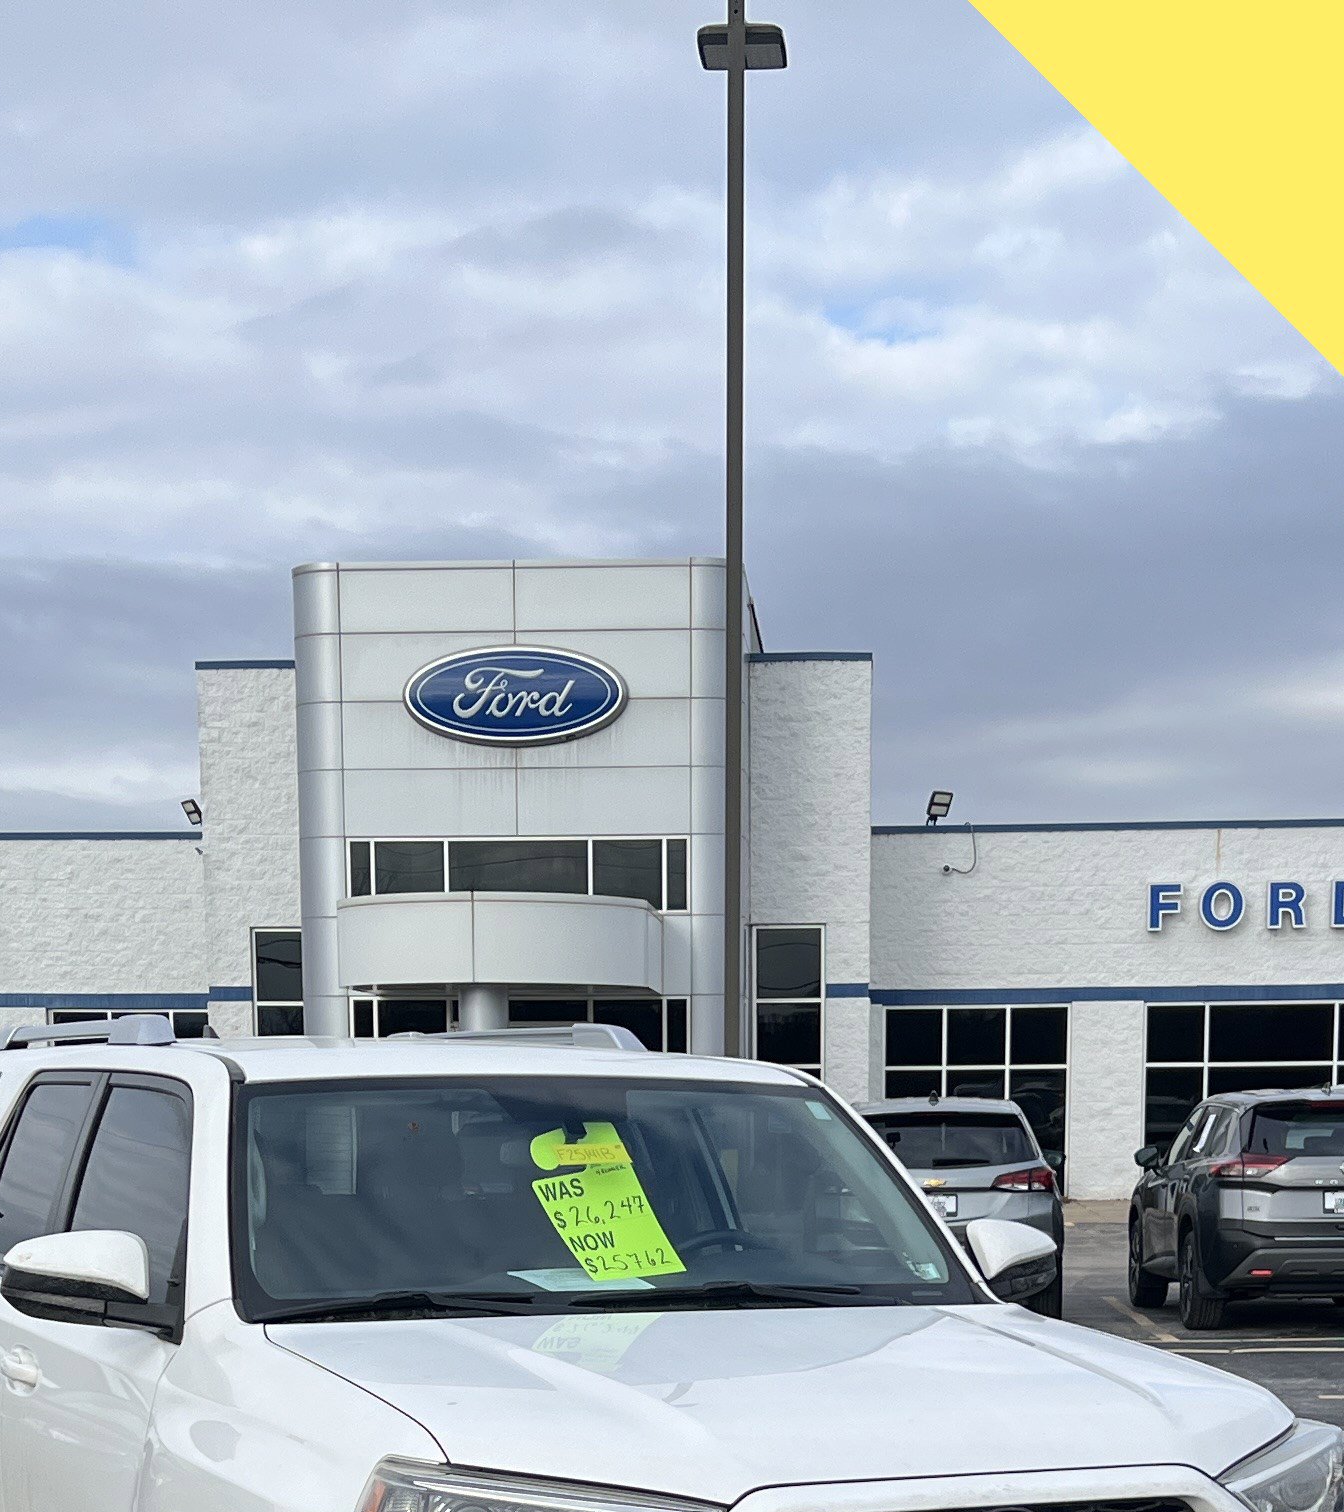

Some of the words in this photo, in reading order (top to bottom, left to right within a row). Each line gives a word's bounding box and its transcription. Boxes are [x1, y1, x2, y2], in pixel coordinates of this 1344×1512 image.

[452, 666, 576, 719] Ford
[538, 1178, 585, 1202] WAS
[569, 1231, 615, 1252] NOW
